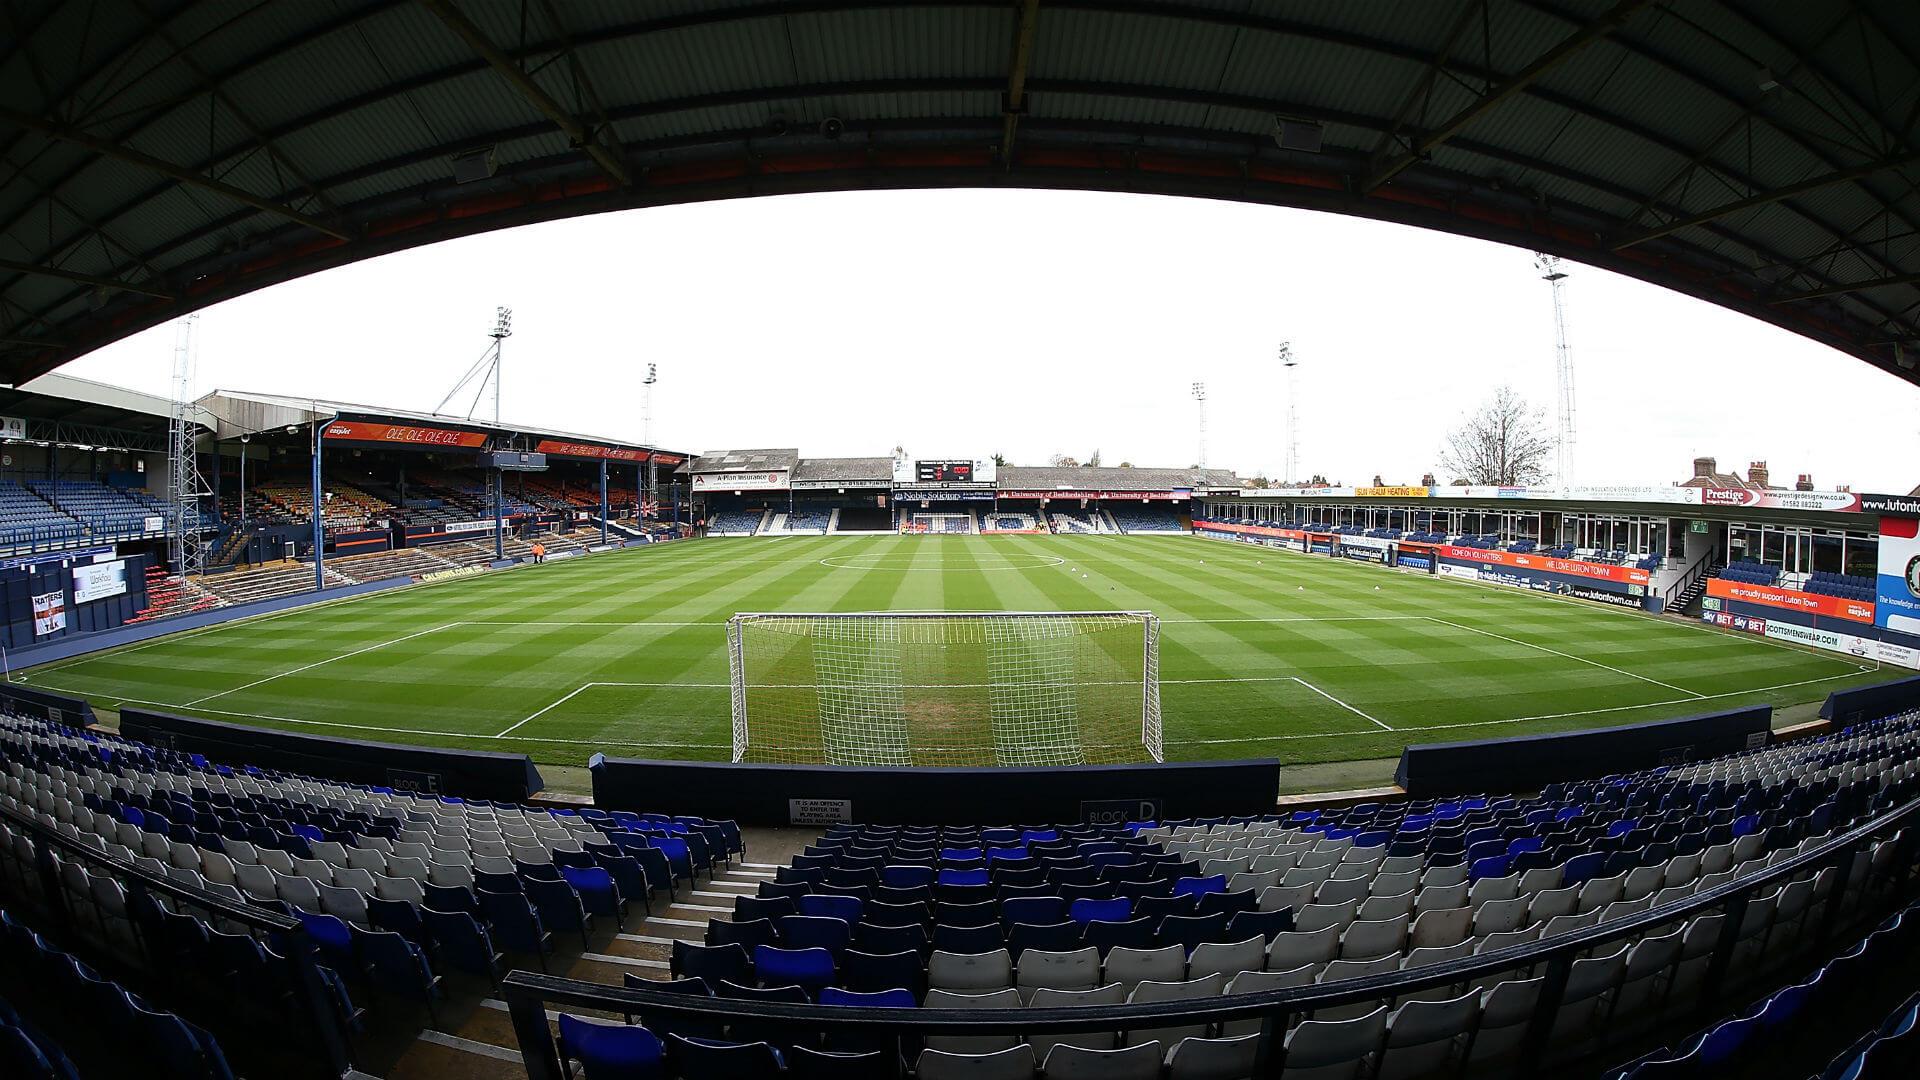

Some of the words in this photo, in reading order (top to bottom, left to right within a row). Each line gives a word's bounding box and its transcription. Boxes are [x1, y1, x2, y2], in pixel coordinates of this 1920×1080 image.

[905, 492, 927, 500] Noble
[927, 491, 961, 500] Solicitors
[1387, 487, 1410, 496] HEATING
[1706, 488, 1744, 502] Prestige
[1546, 560, 1555, 569] WE
[1555, 561, 1570, 571] LOVE
[1570, 564, 1590, 573] LUTON
[1574, 589, 1641, 607] www.lutontown.co.uk
[1739, 589, 1761, 599] proudly
[1761, 592, 1784, 602] support
[1785, 595, 1801, 604] Luton
[1802, 598, 1818, 608] Town
[1879, 595, 1888, 603] The
[1703, 611, 1716, 622] sky
[1717, 615, 1732, 624] BET
[1848, 608, 1871, 618] easyJet
[1734, 618, 1747, 629] sky
[1748, 621, 1764, 632] BET
[1766, 624, 1838, 646] SCOTTSMENSWEAR.COM
[427, 775, 438, 792] E
[1090, 811, 1128, 822] BLOCK
[1140, 801, 1156, 820] D
